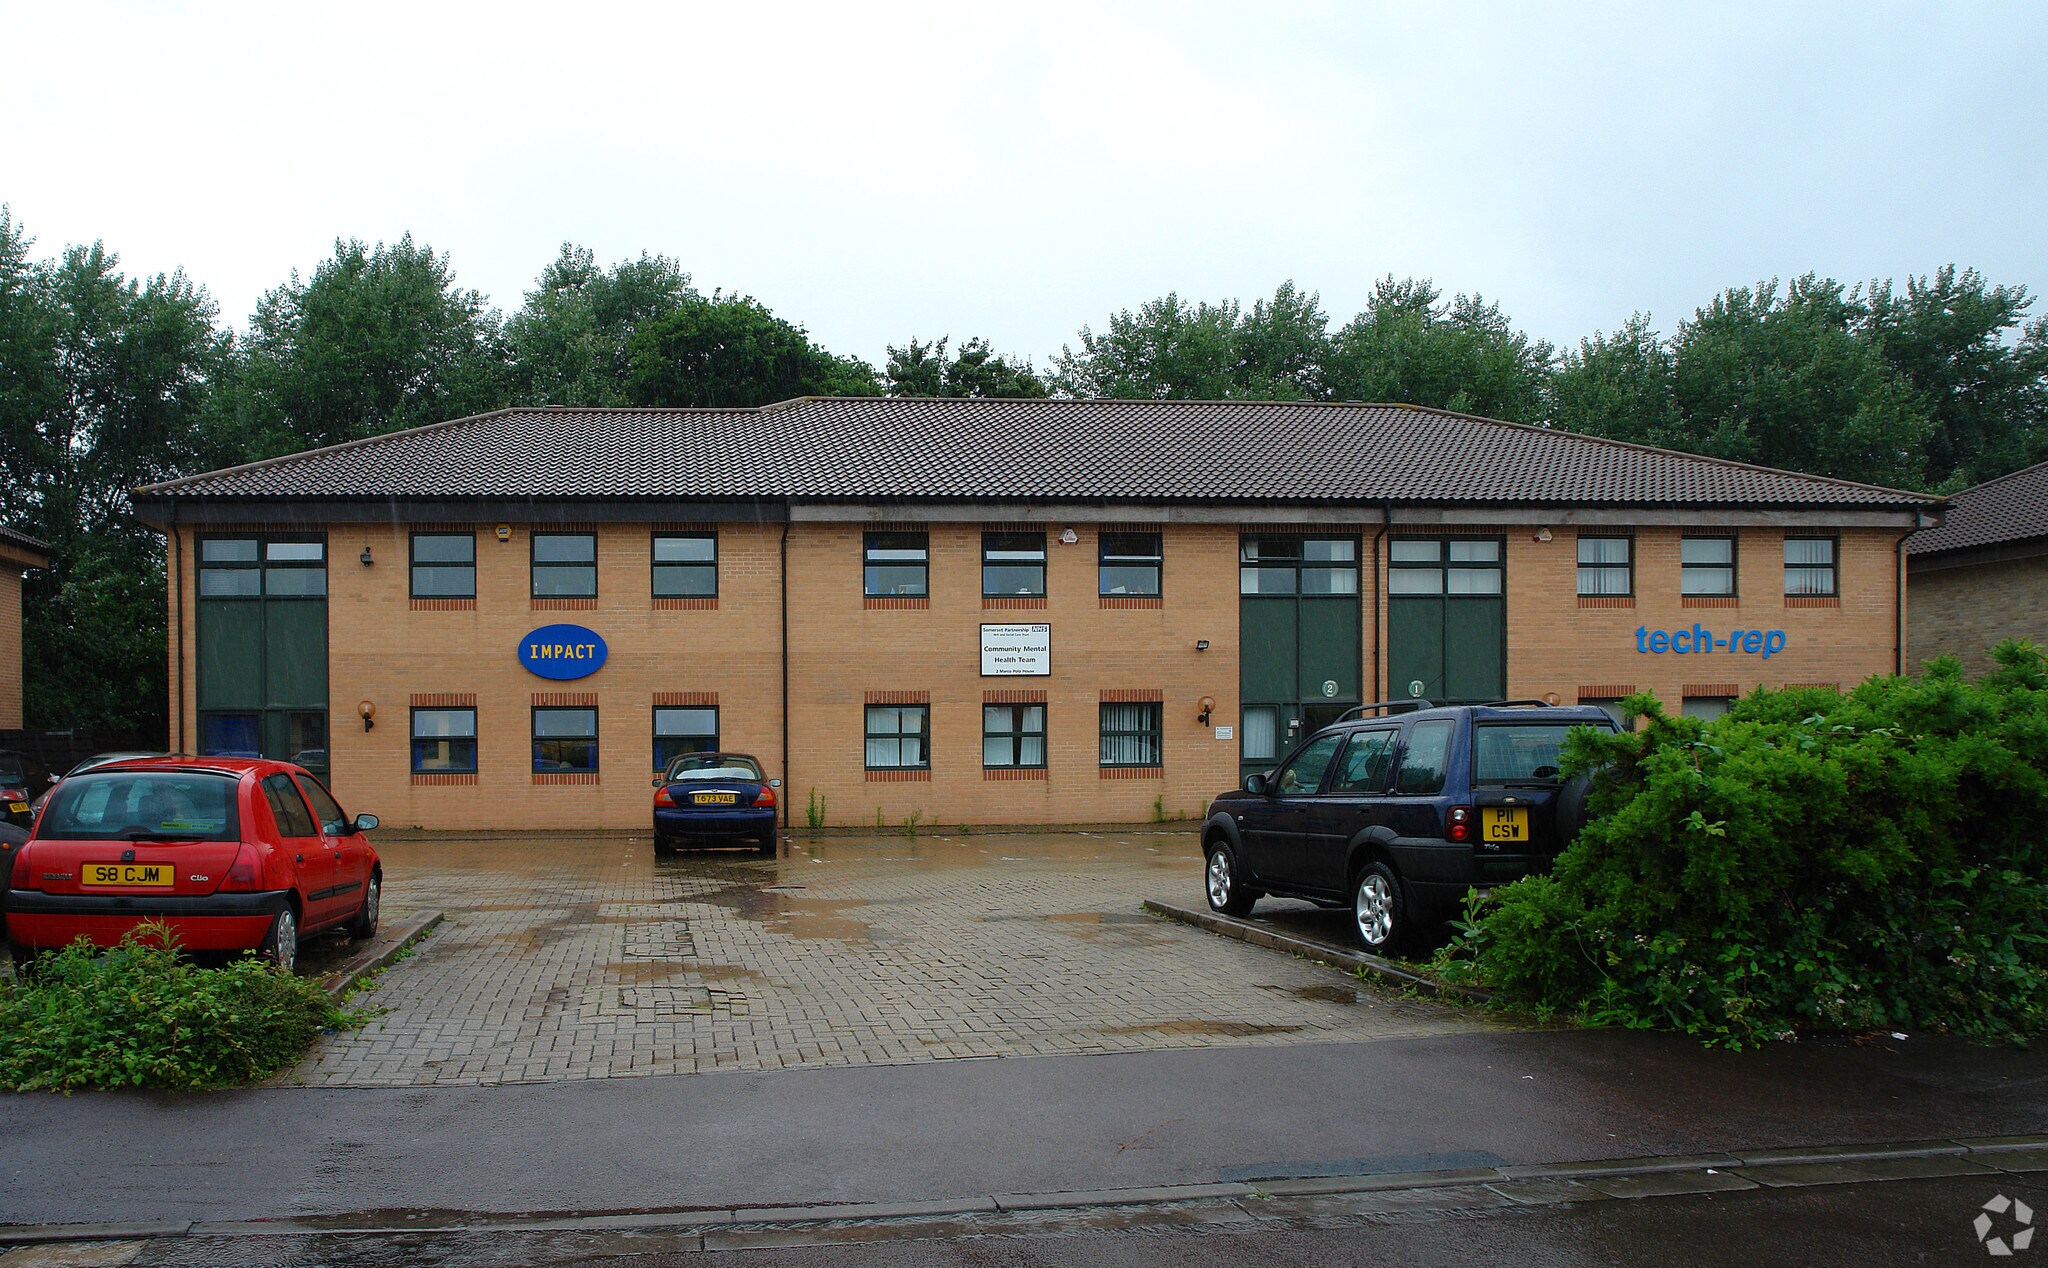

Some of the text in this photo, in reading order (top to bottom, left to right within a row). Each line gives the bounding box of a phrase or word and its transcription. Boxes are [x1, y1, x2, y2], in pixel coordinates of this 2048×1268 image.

[1635, 623, 1786, 659] tech-rep
[530, 644, 595, 659] IMPACT
[983, 645, 1021, 653] Community
[1327, 684, 1333, 693] 2
[1492, 824, 1519, 838] CSW
[96, 867, 159, 882] S8 CJM
